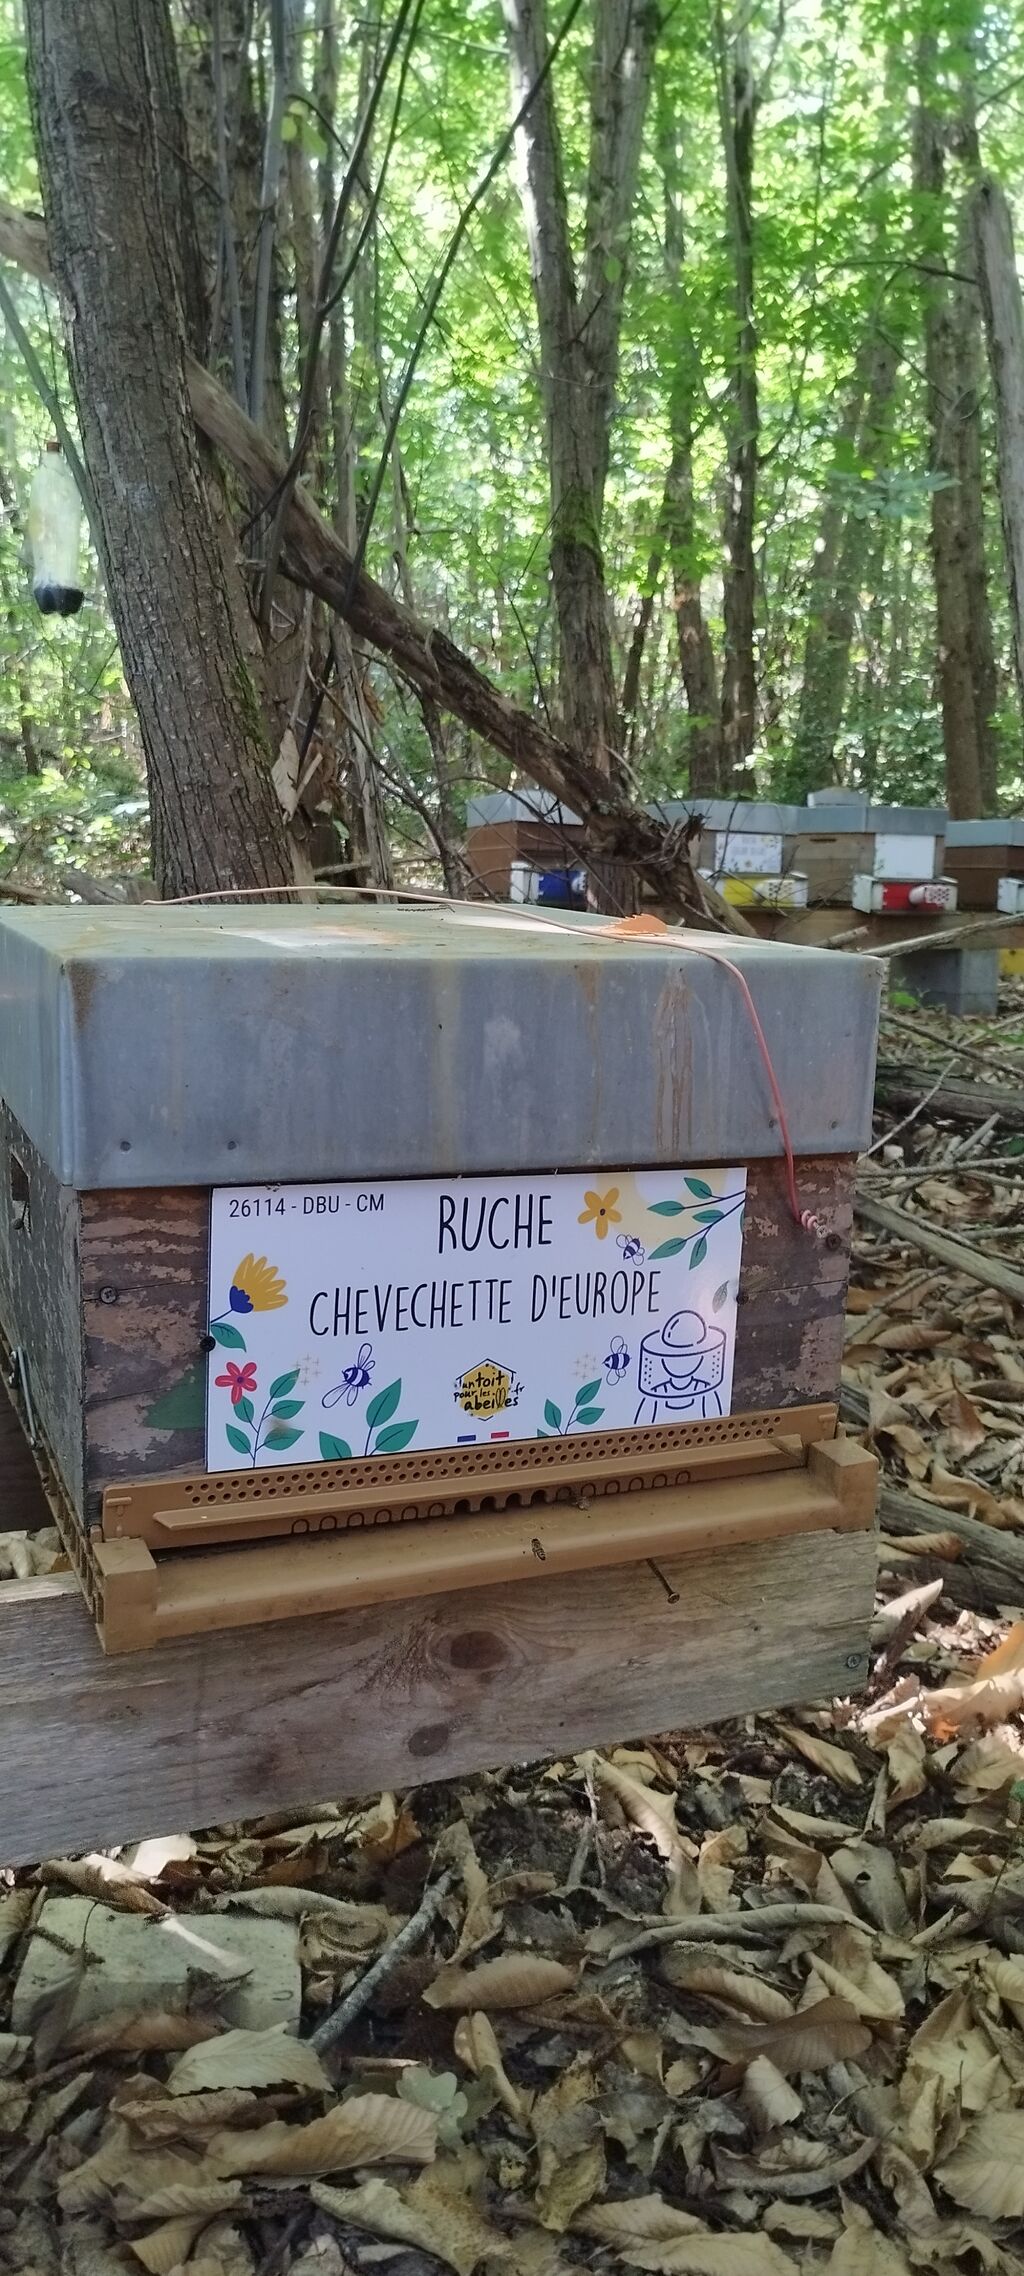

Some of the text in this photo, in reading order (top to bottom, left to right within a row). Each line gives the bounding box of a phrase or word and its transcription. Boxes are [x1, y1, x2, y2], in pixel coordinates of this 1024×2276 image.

[229, 1198, 286, 1218] 26114
[303, 1195, 340, 1215] DBU
[356, 1193, 385, 1212] CM
[438, 1194, 553, 1253] RUCHE
[309, 1271, 661, 1336] CHEVECHETTE D'EUROPE
[453, 1388, 490, 1402] pour les
[464, 1387, 519, 1411] abeilles
